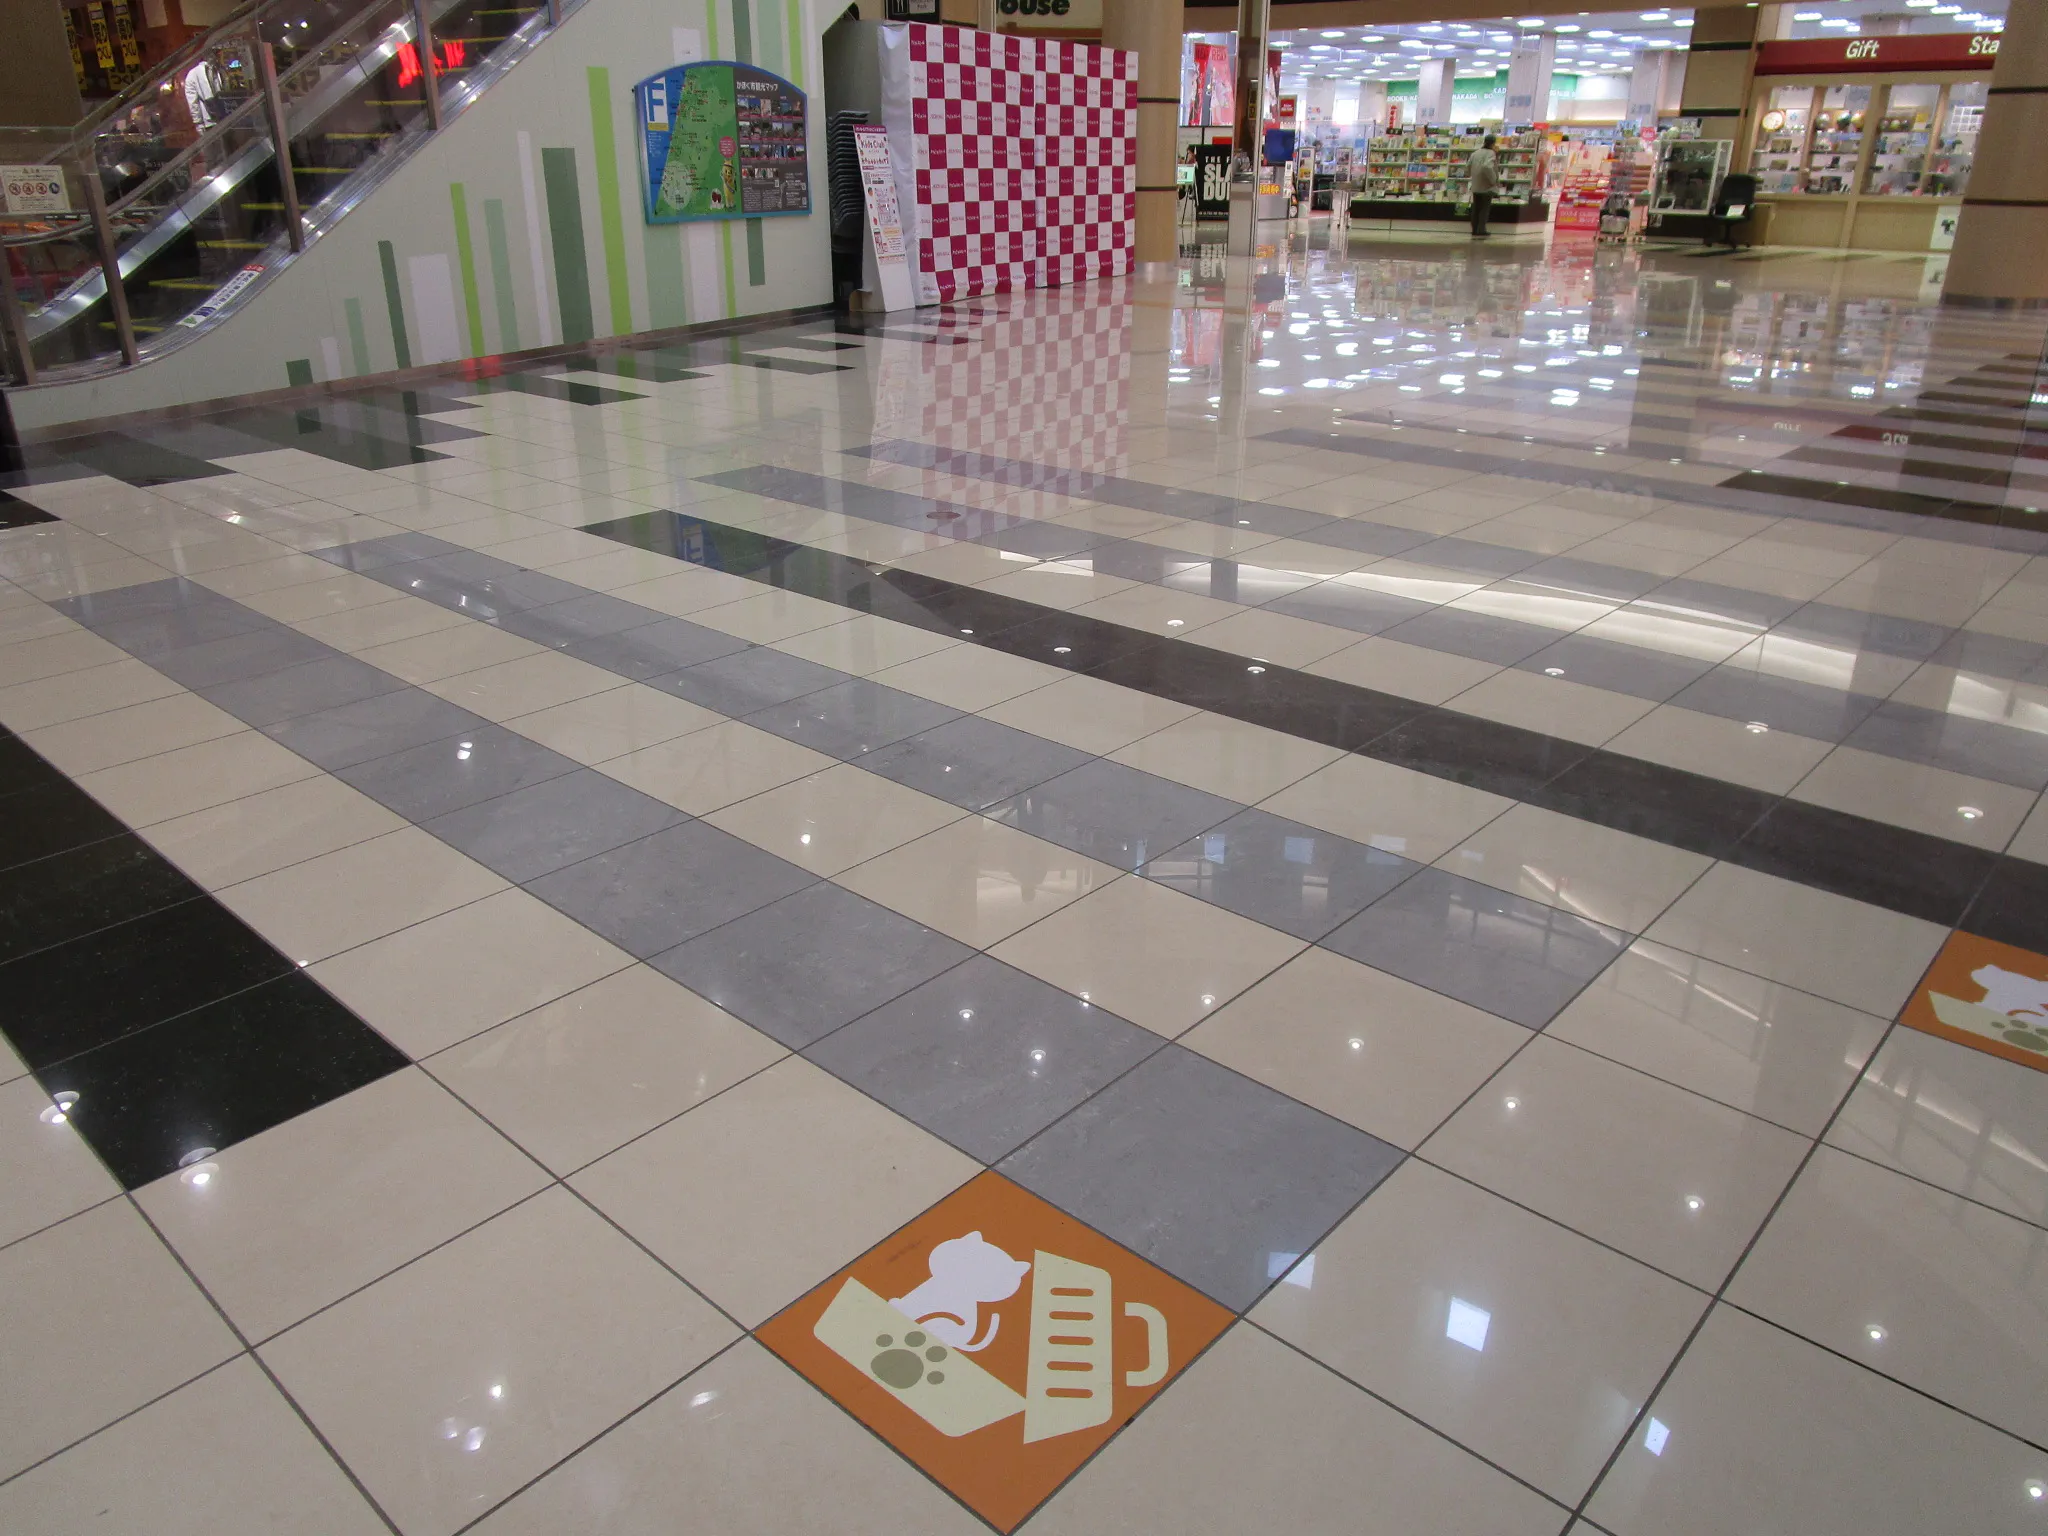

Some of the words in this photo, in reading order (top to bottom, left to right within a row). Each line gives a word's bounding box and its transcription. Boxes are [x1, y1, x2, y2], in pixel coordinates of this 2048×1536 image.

[996, 0, 1071, 15] ouse
[1846, 40, 1880, 58] Gift
[736, 81, 779, 92] かほく市観光マップ
